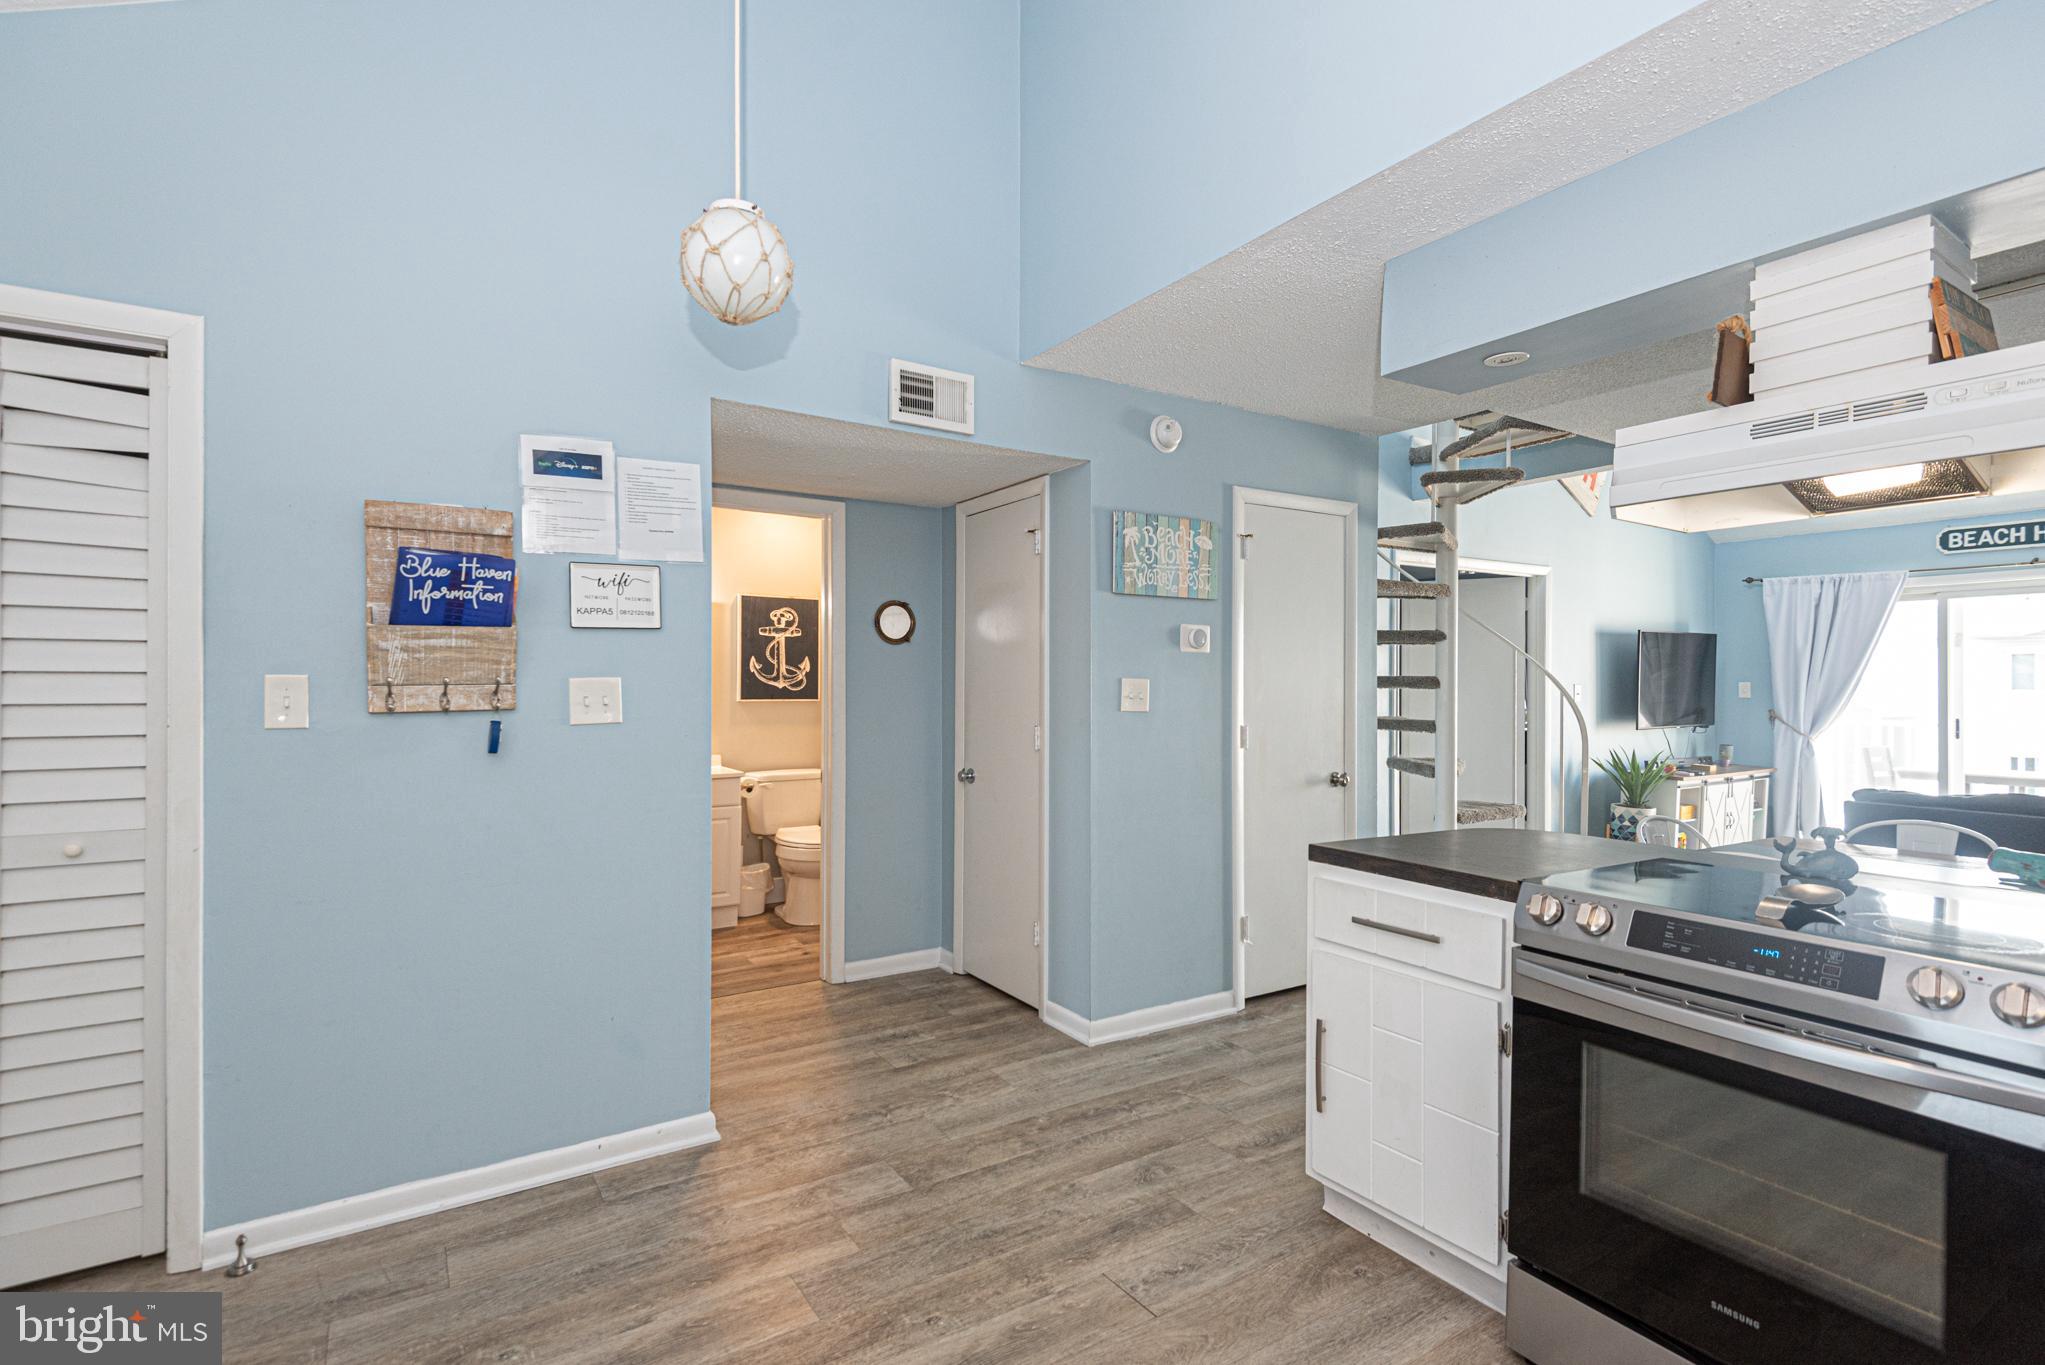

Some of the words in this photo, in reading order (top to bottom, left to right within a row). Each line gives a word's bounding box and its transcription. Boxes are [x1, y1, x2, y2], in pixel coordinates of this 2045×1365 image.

[1948, 525, 2027, 548] BEACH
[400, 555, 451, 578] Blue
[458, 557, 512, 582] Haven
[409, 579, 504, 615] Information
[1711, 1300, 1760, 1330] SAMSUNG
